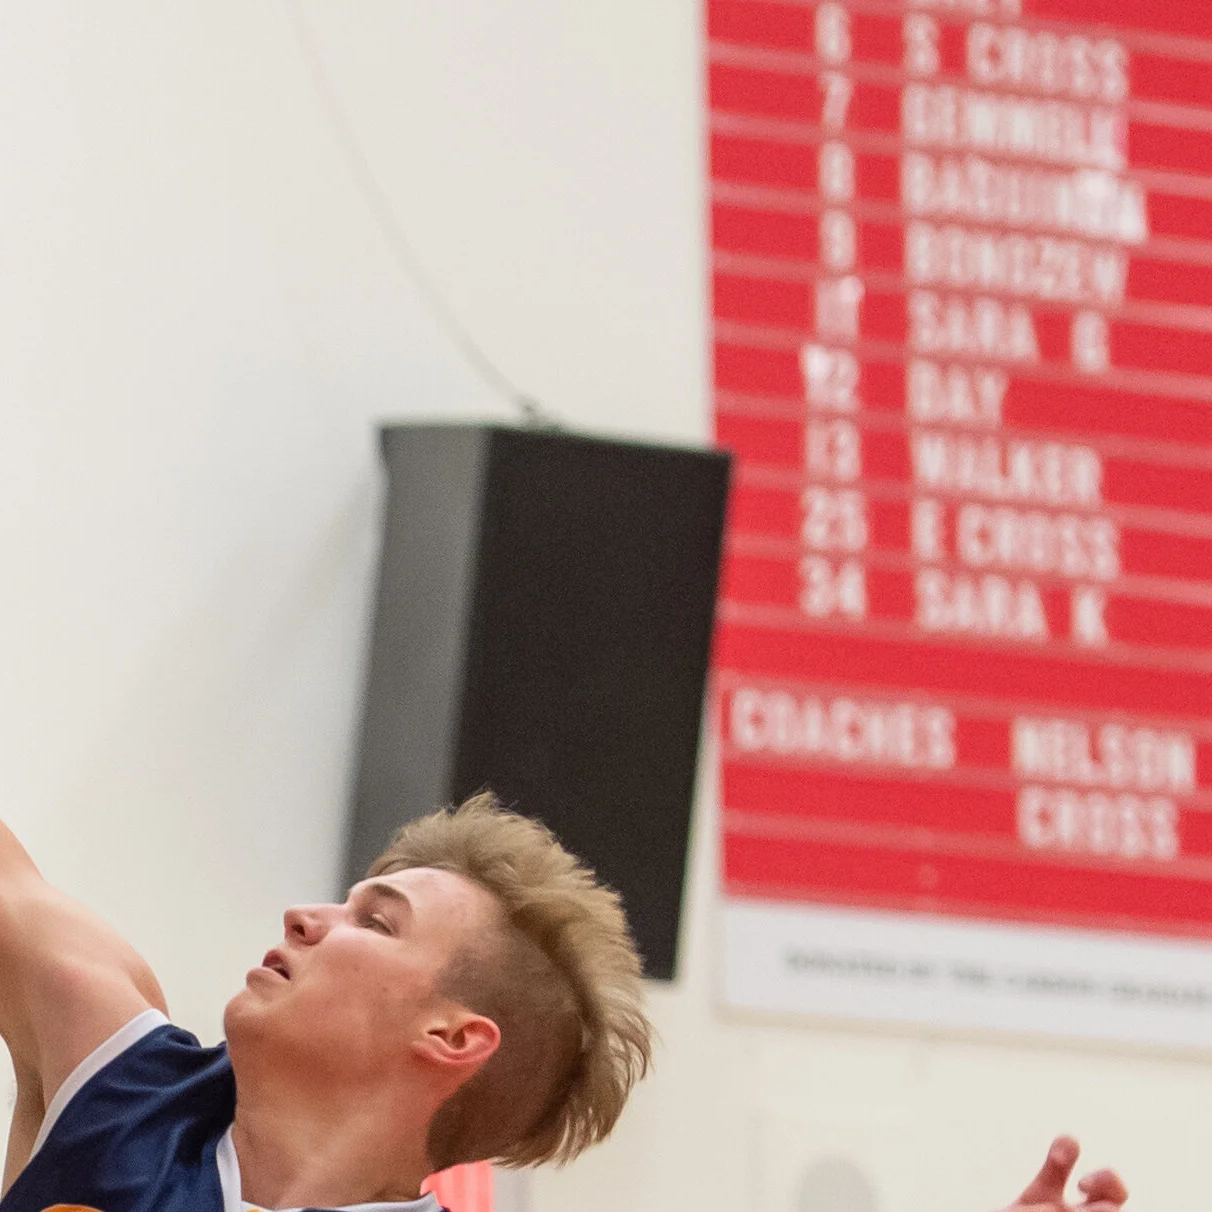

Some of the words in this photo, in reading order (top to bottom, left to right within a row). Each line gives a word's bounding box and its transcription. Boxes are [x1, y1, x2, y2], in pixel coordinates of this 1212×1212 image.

[904, 12, 939, 76] S
[967, 21, 1129, 100] CROSS
[821, 70, 852, 133] 7
[908, 288, 1039, 364] SARA
[800, 343, 859, 413] 12
[907, 356, 1009, 431] DAY
[806, 418, 860, 482] 13
[912, 429, 1102, 511] WALKER
[802, 485, 868, 553] 25
[957, 502, 1120, 583] CROSS
[801, 553, 866, 621] 34
[915, 566, 1048, 643] SARA
[1072, 584, 1108, 649] K
[731, 688, 956, 770] COACHES
[1013, 717, 1196, 796] NELSON
[1018, 784, 1179, 861] CROSS
